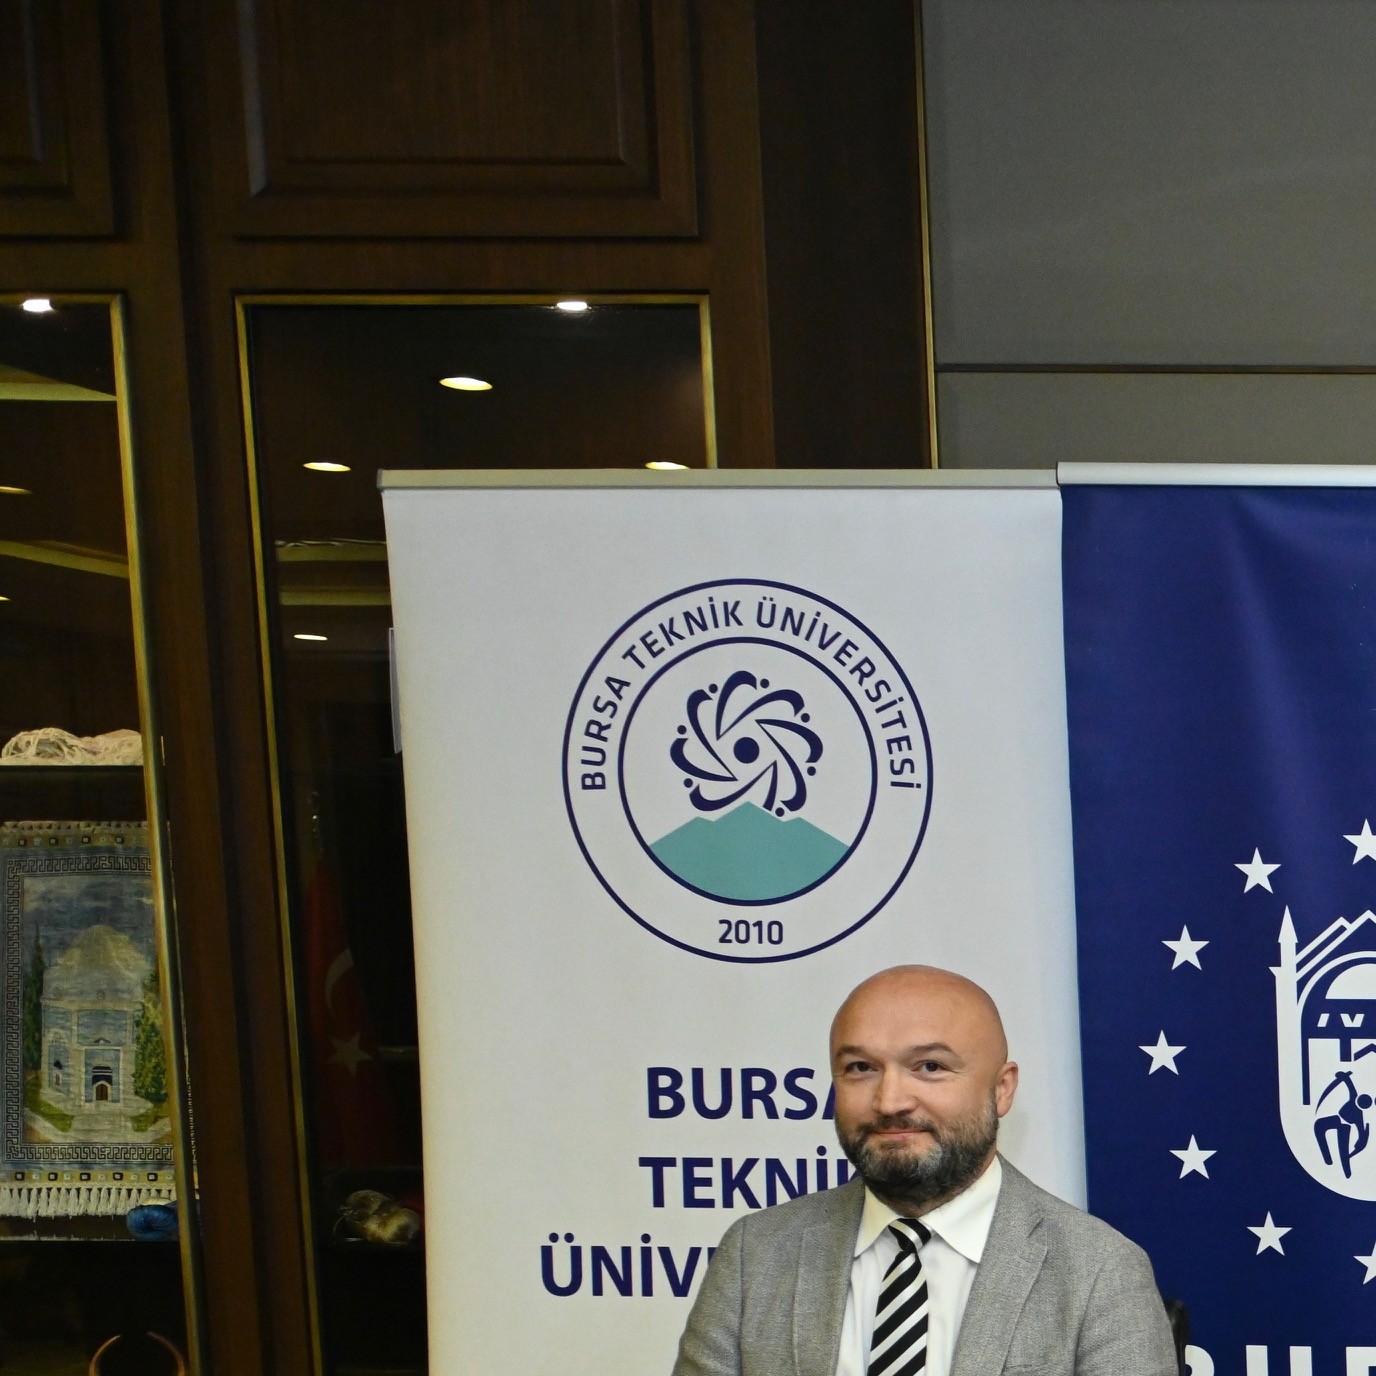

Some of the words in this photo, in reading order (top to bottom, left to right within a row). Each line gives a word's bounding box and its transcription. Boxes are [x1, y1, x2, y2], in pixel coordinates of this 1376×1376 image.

[580, 675, 631, 791] BURSA
[621, 596, 743, 673] TEKNİK
[756, 596, 922, 790] ÜNİVERSİTESİ
[718, 919, 784, 945] 2010
[540, 1233, 719, 1298] ÜNİV
